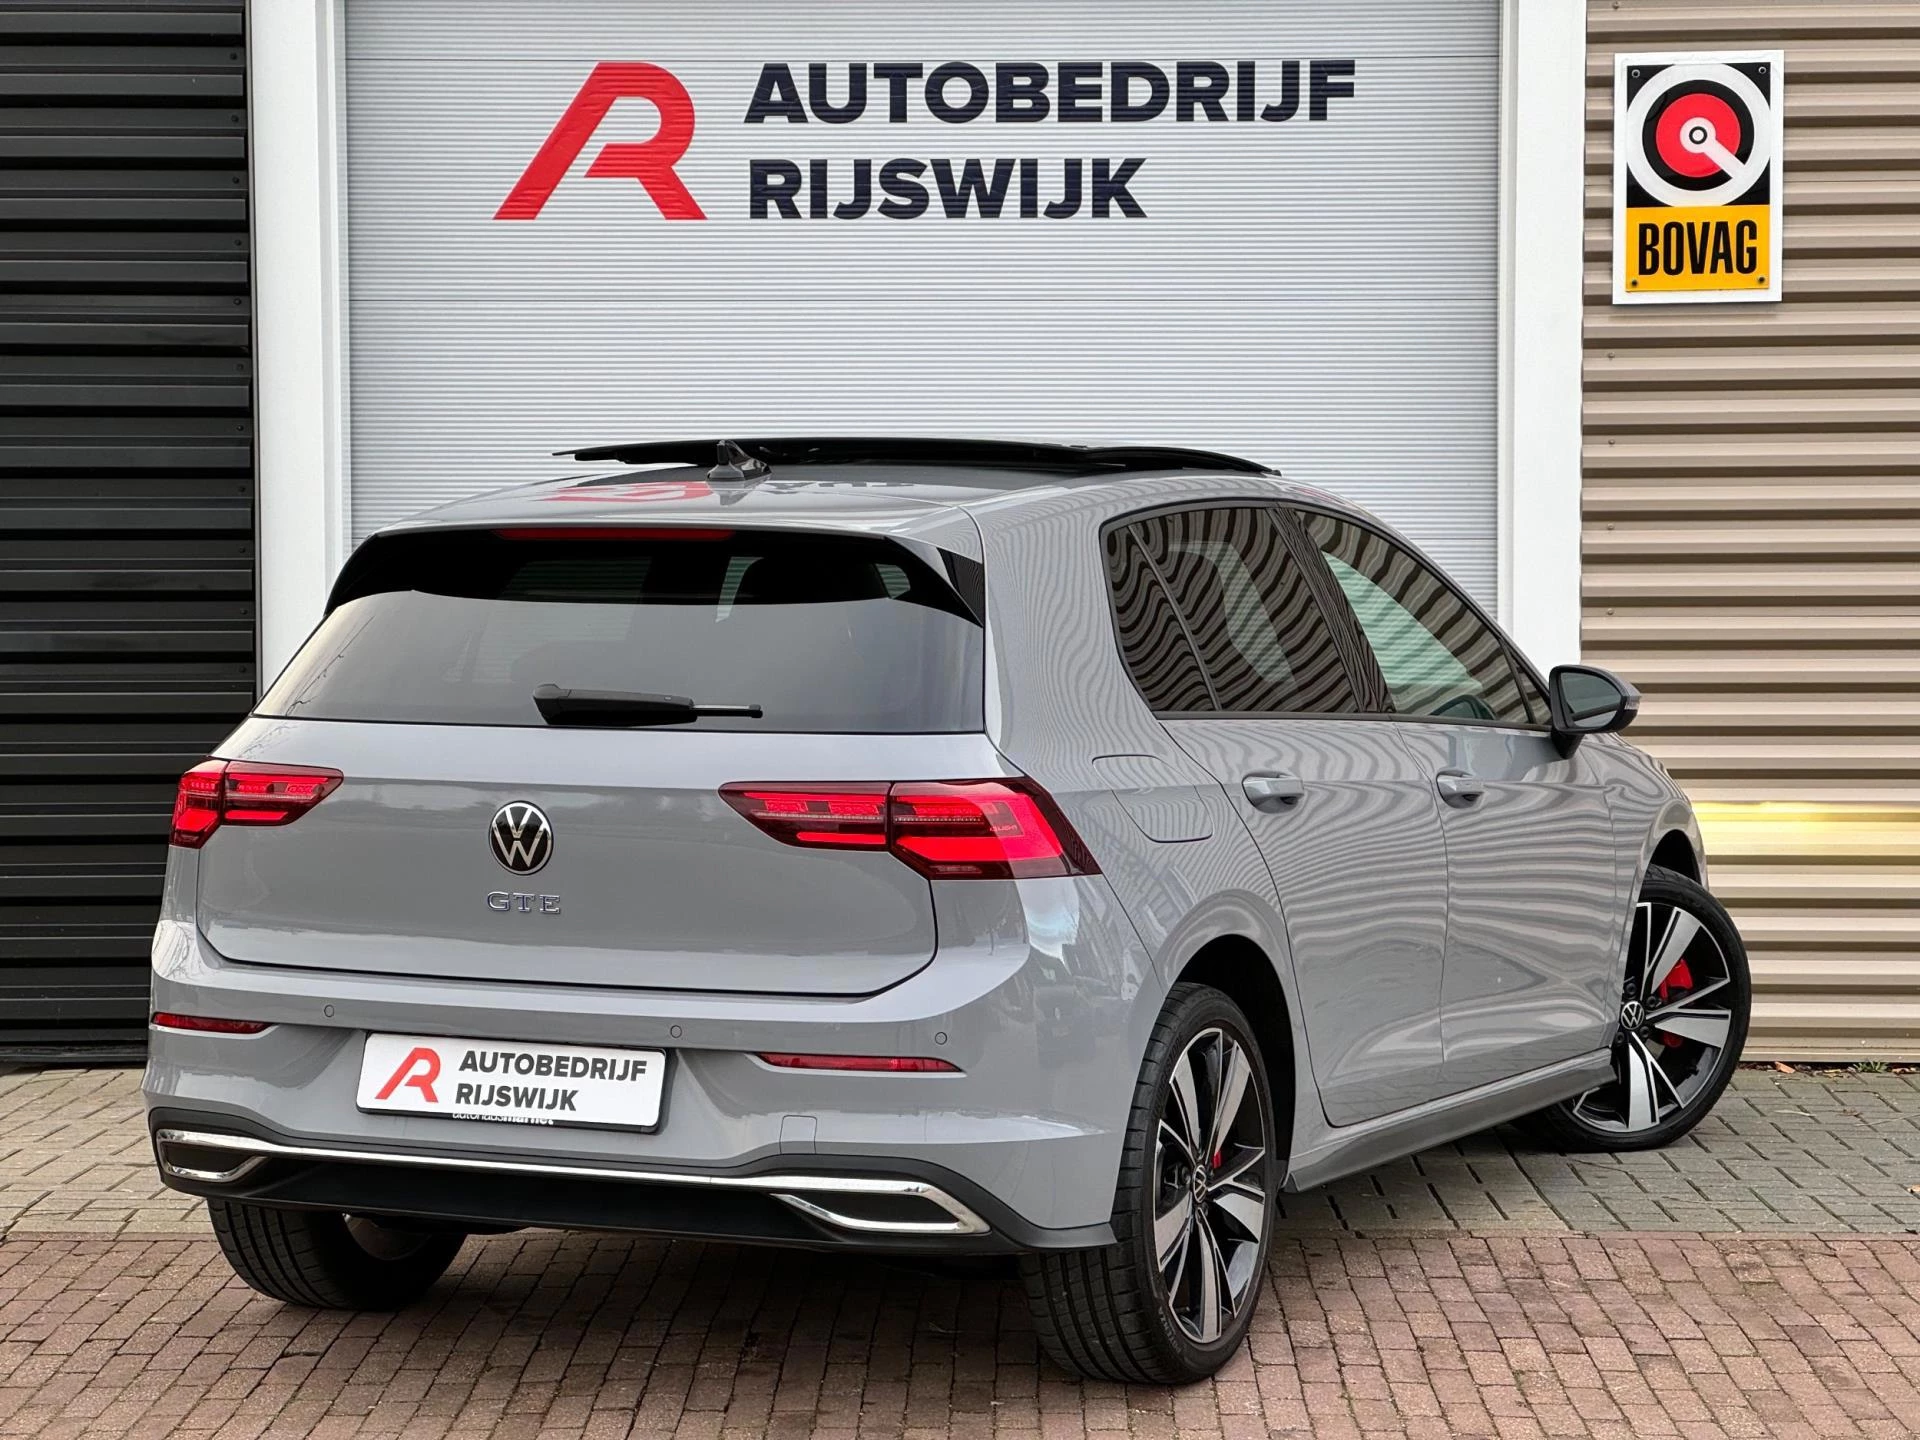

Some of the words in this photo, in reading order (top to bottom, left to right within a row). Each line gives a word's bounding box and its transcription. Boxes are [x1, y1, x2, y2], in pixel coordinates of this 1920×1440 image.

[744, 60, 1356, 124] AUTOBEDRIJF
[749, 158, 1148, 220] RIJSWIJK
[1638, 219, 1757, 276] BOVAG
[487, 891, 561, 914] GTE
[458, 1050, 648, 1082] AUTOBEDRIJF
[455, 1083, 579, 1112] RIJSWIJK
